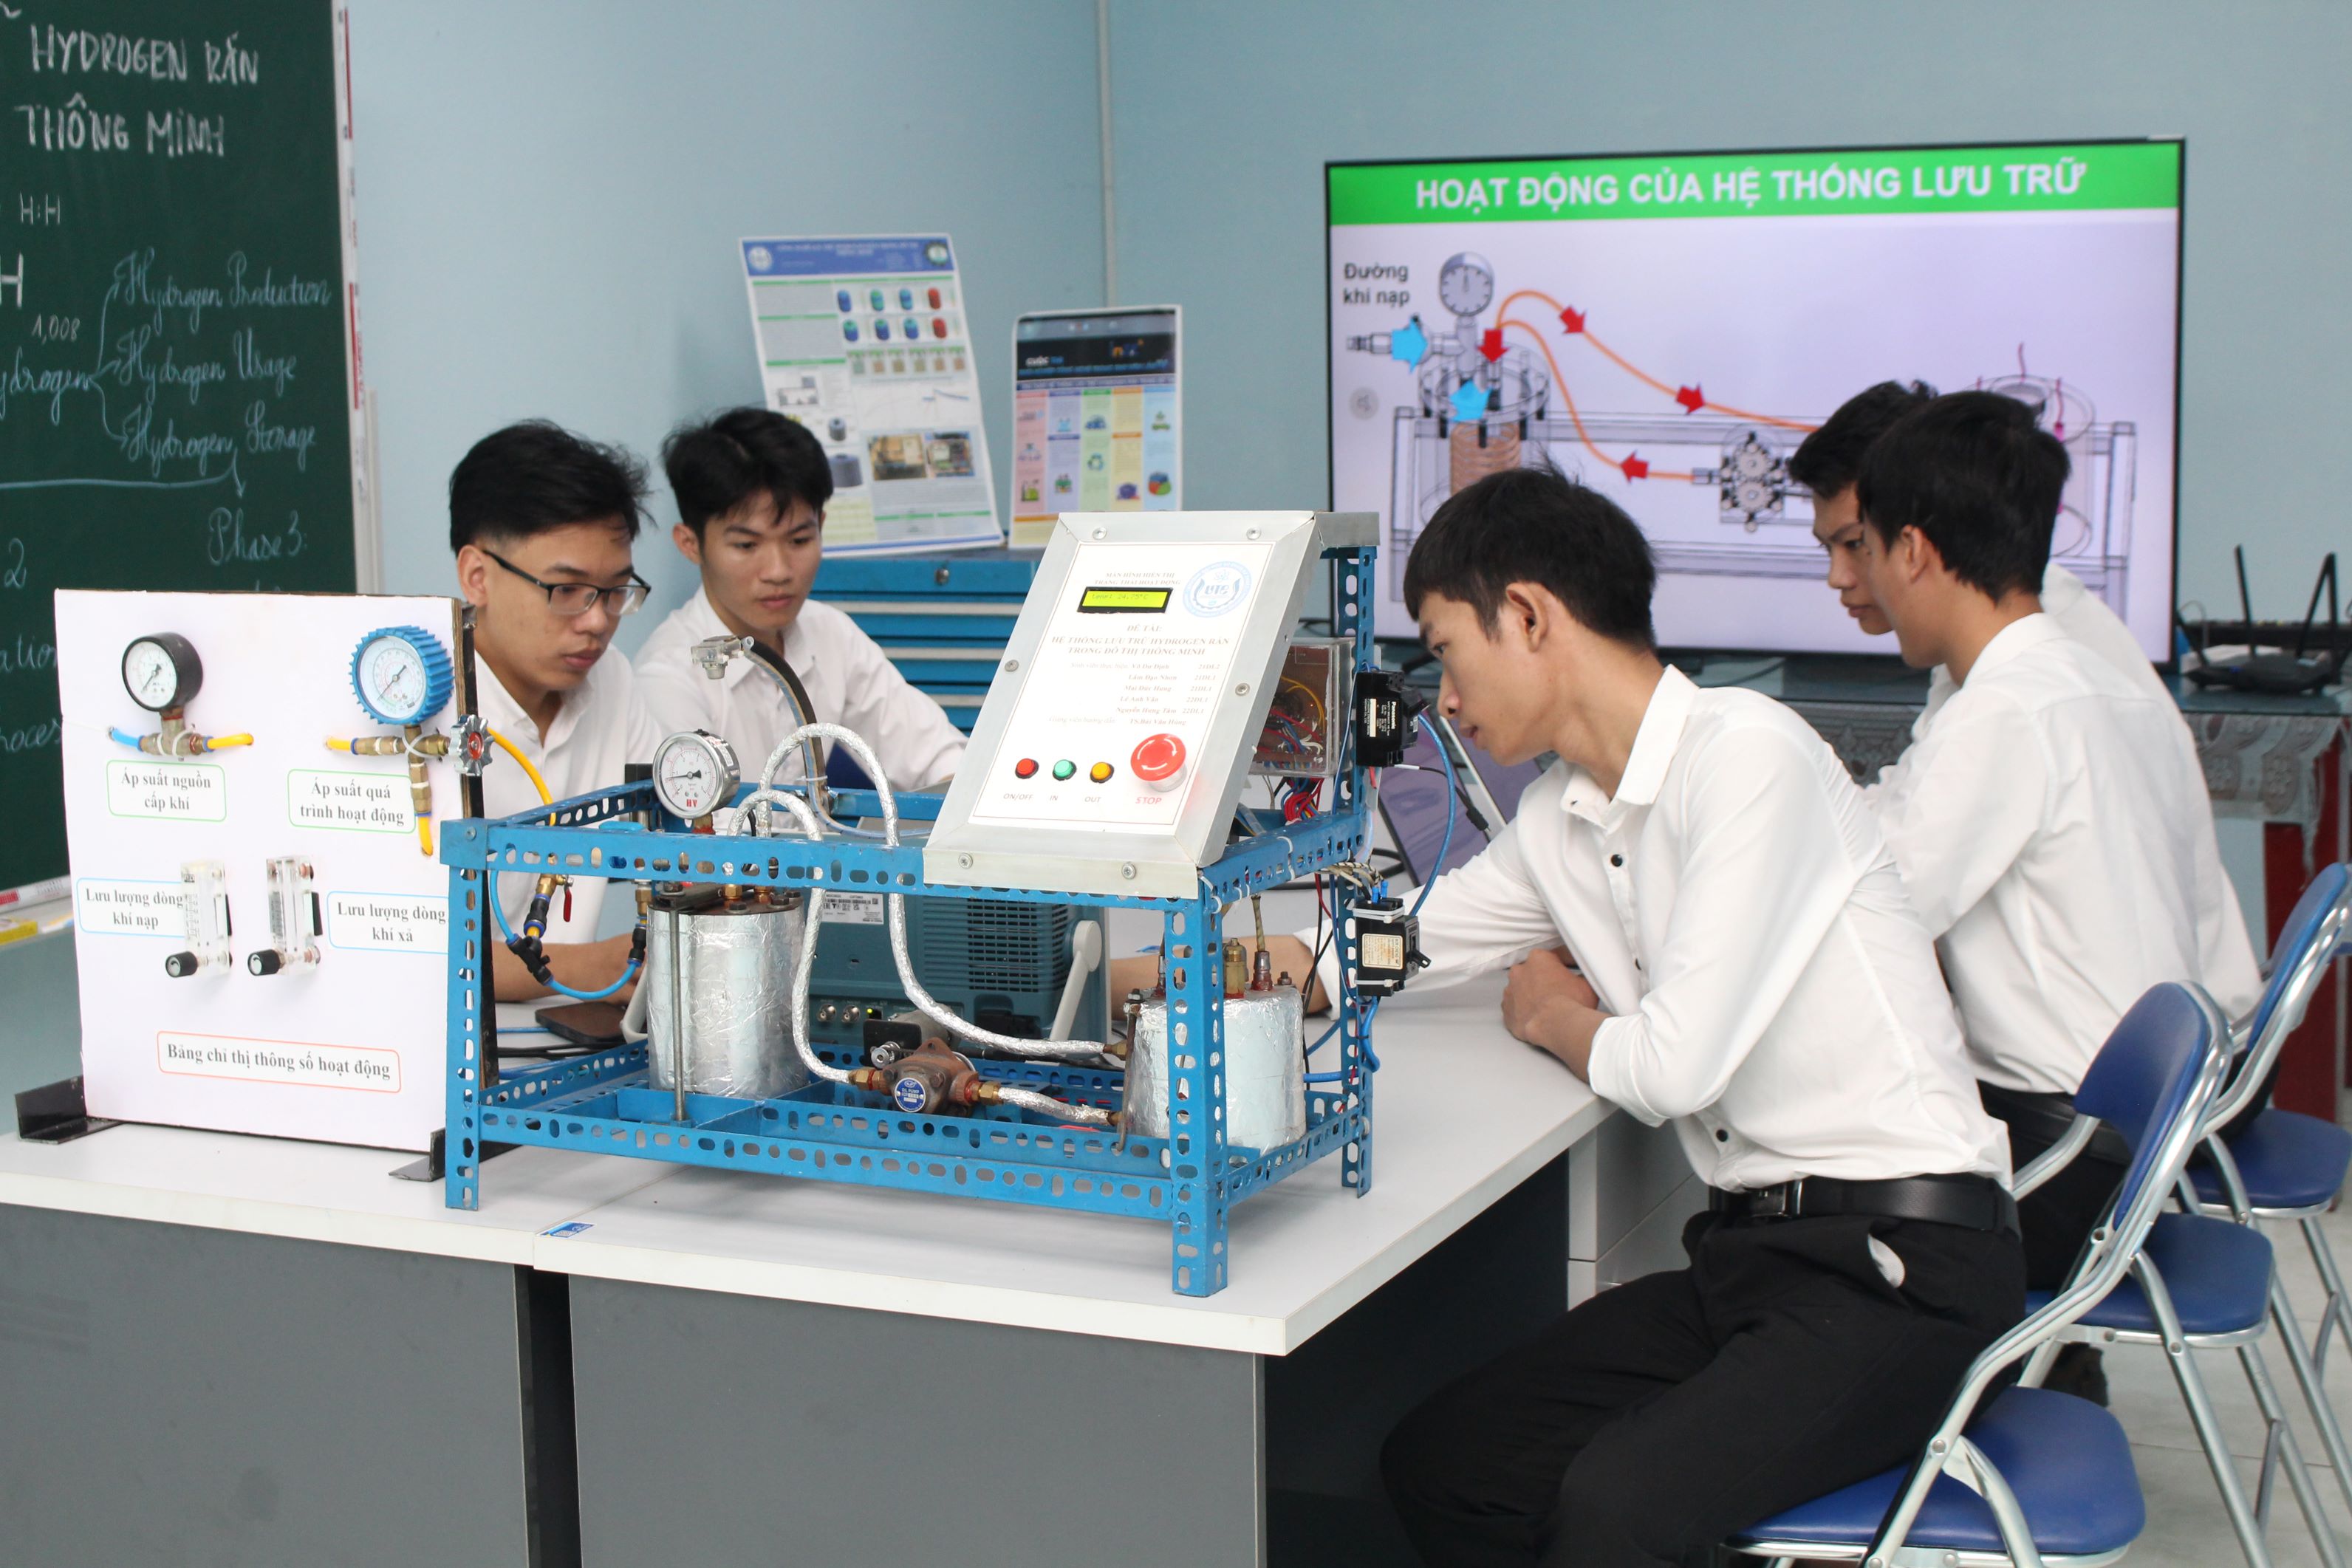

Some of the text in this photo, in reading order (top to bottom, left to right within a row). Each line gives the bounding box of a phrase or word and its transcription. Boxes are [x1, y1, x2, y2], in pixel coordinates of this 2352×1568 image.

[30, 23, 188, 81] HYDROGEN
[14, 92, 130, 151] THÔNG
[1416, 177, 1509, 214] HOẠT
[1517, 170, 1620, 213] ĐỘNG
[1628, 167, 1703, 204] CỦA
[1713, 167, 1761, 210] HỆ
[1912, 164, 1992, 198] LƯU
[2003, 157, 2088, 195] TRỮ
[1344, 261, 1409, 284] Đường
[114, 247, 331, 335] Hydrogen Production
[1375, 288, 1411, 309] nạp
[117, 324, 226, 404] Hydrogen
[123, 403, 234, 479] Hydrogen
[208, 507, 282, 565] Phase
[120, 765, 211, 792] Áp suất nguồn
[144, 790, 191, 812] cấp khí
[310, 779, 392, 804] Áp suất quá
[1135, 796, 1162, 805] STOP
[300, 803, 405, 827] trình hoạt động
[86, 886, 111, 903] Lưu
[114, 887, 150, 908] lượng
[152, 889, 184, 909] dòng
[112, 909, 159, 929] khí nạp
[337, 900, 446, 924] Lưu lượng dòng
[372, 925, 414, 943] khí xả
[167, 1044, 204, 1064] Bảng
[231, 1049, 251, 1068] thị
[254, 1052, 295, 1072] thông
[298, 1050, 315, 1070] số
[318, 1055, 349, 1076] hoạt
[354, 1058, 392, 1080] động
